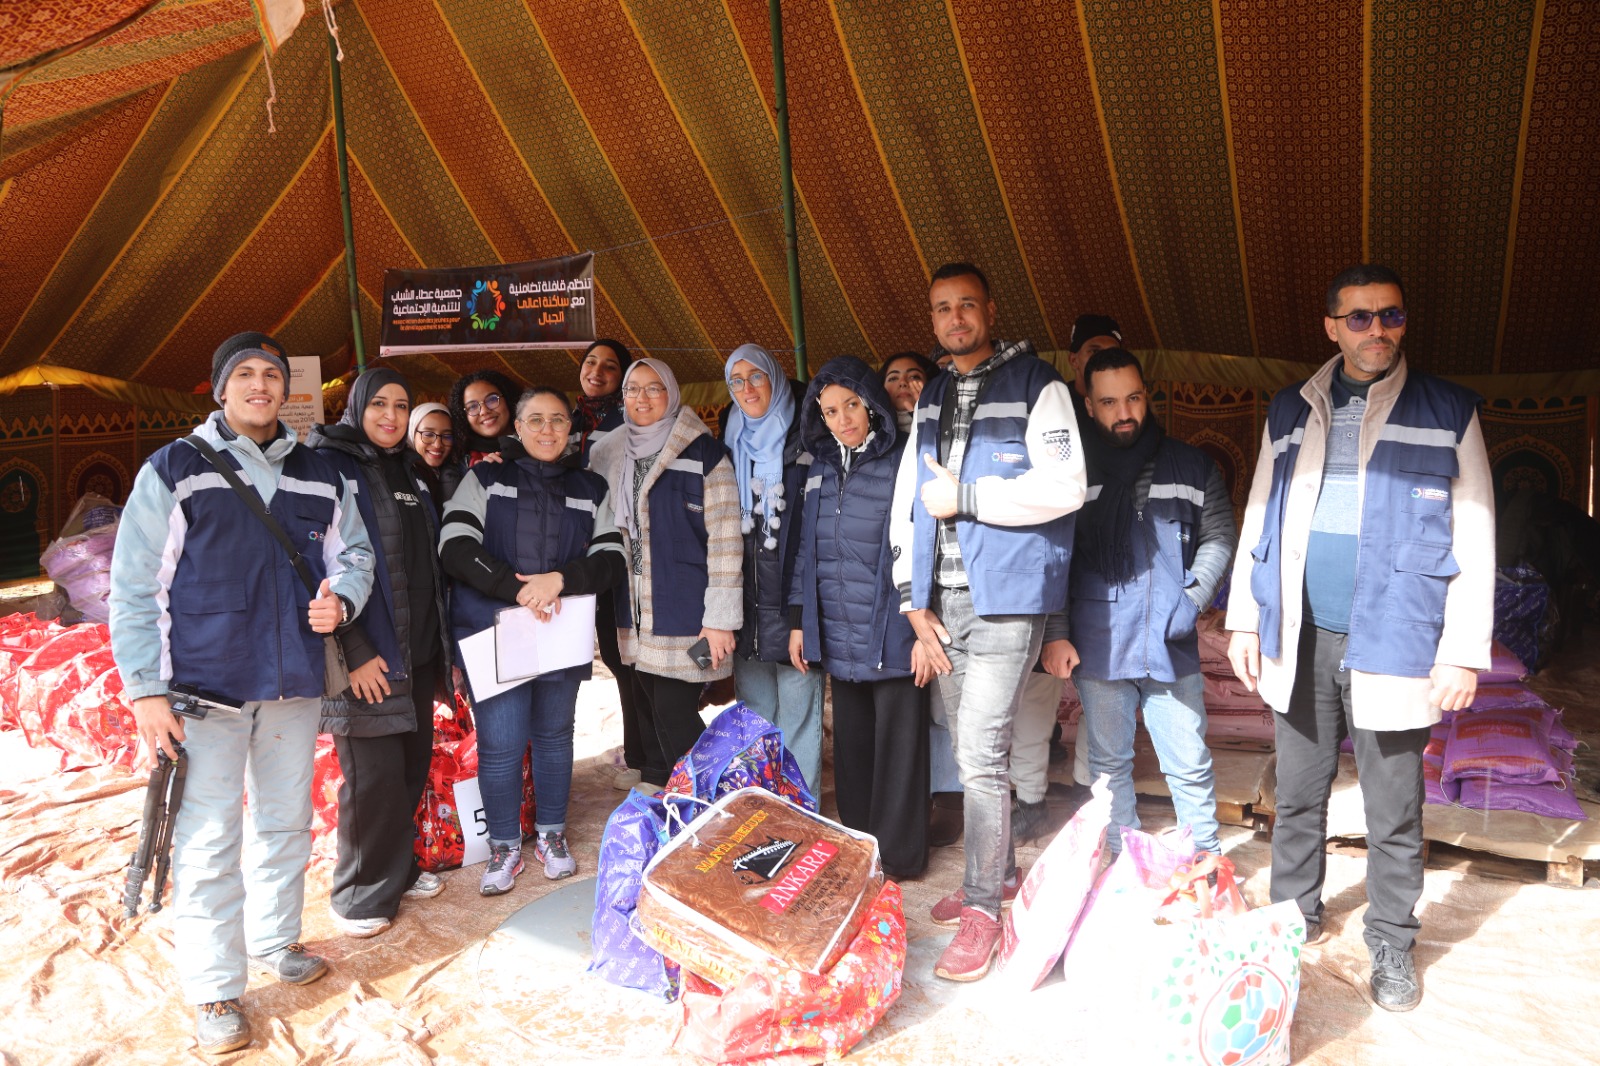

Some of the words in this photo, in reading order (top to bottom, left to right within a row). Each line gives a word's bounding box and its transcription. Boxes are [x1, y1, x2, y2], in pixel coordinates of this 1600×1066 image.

[509, 282, 541, 296] تضامنية
[542, 280, 566, 292] قافلة
[391, 289, 414, 303] الشباب
[416, 290, 433, 299] عطاء
[435, 289, 462, 300] جمعية
[431, 302, 460, 314] للتنمية
[543, 295, 569, 308] ساكنة
[570, 297, 585, 308] مع
[538, 311, 564, 325] الجبال
[474, 808, 488, 836] 5
[769, 848, 831, 908] ANKARA
